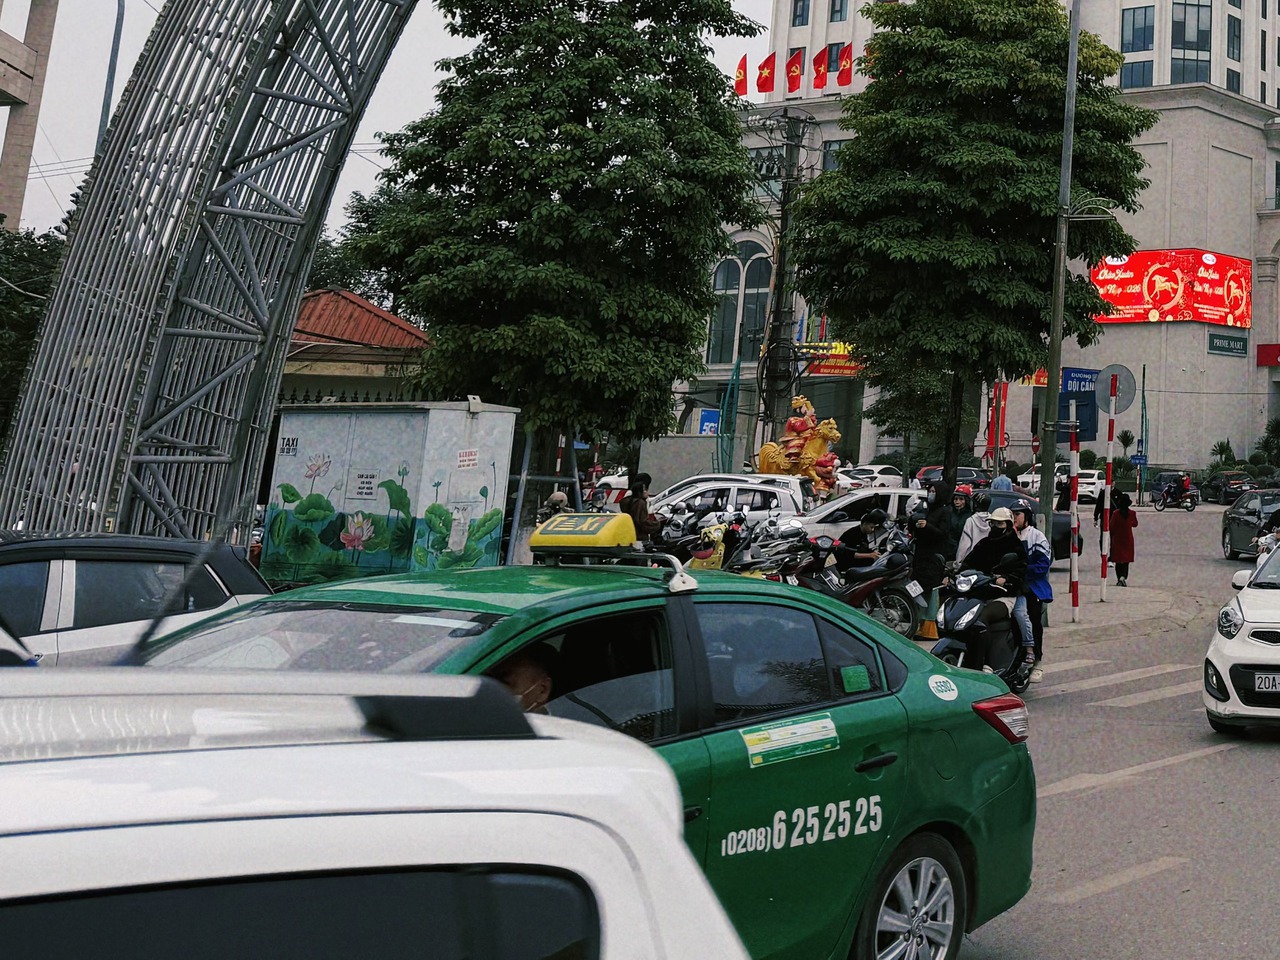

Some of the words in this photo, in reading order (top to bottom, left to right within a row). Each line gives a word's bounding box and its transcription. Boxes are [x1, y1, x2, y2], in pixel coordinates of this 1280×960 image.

[1213, 338, 1230, 348] PRIME
[1229, 340, 1244, 350] MART
[281, 437, 299, 448] TAXI
